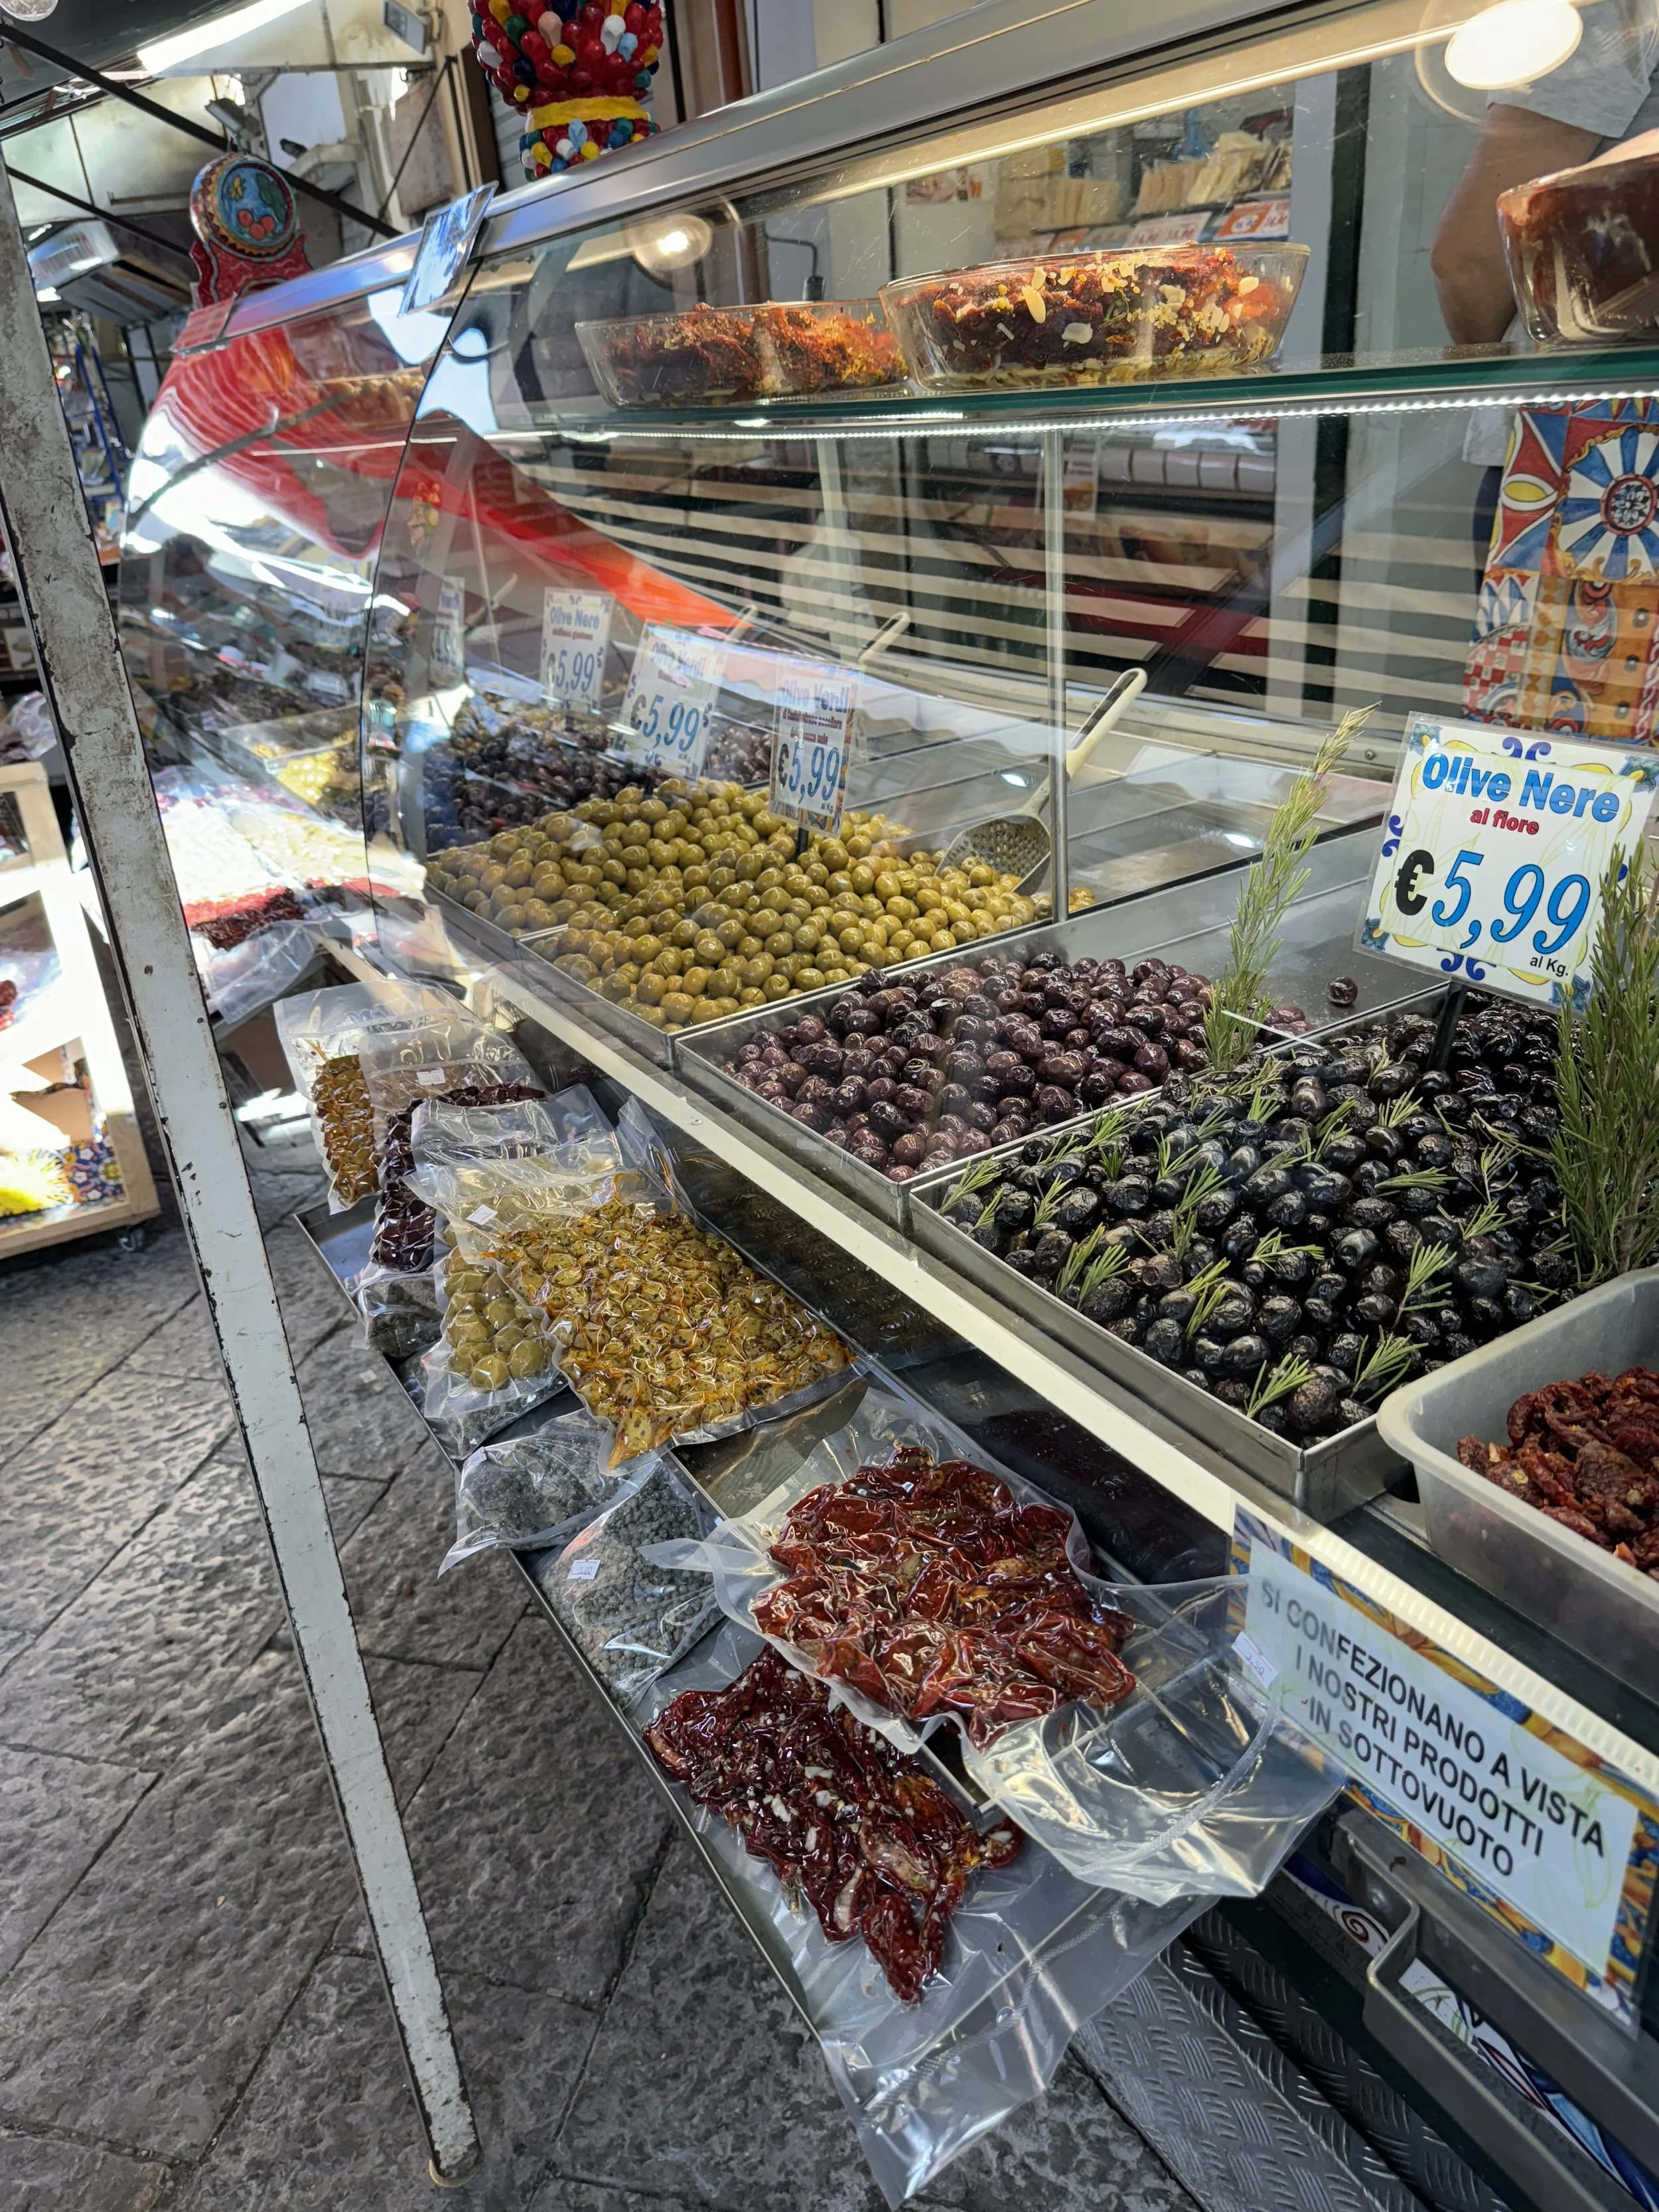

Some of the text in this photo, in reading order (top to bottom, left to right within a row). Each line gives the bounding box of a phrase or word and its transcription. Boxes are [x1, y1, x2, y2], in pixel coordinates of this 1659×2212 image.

[1422, 753, 1620, 823] Olive Nere
[1470, 808, 1540, 836] al fiore
[1530, 956, 1569, 978] al Kg.
[1261, 1581, 1605, 1858] SI CONFEZIONANO A VISTA
[1295, 1645, 1544, 1857] I NOSTRI PRODOTTI
[1309, 1696, 1514, 1877] IN SOTTOVUOTO
